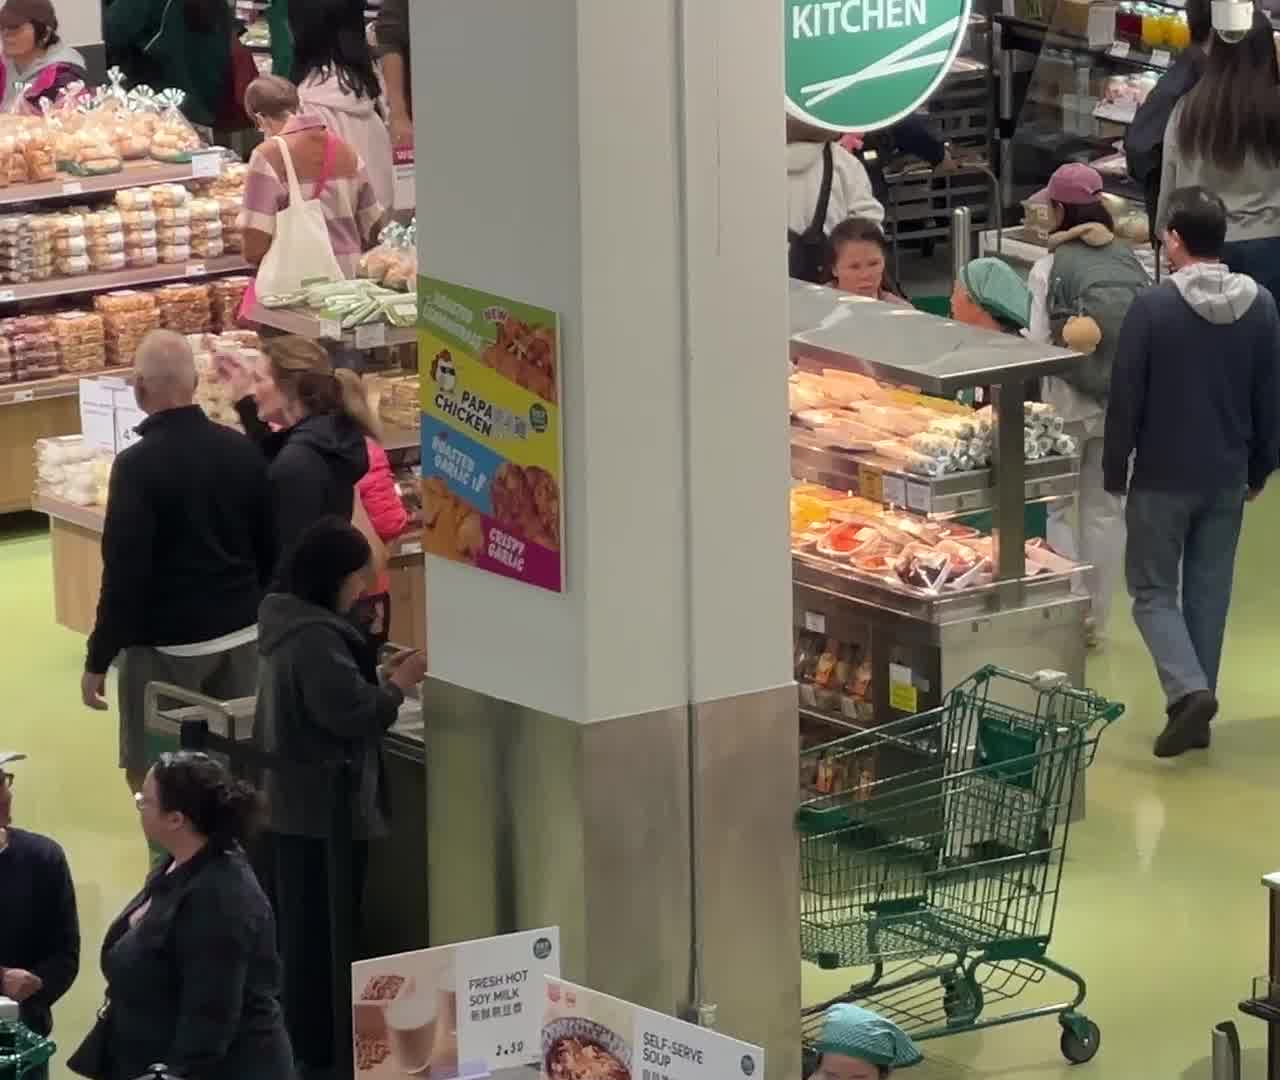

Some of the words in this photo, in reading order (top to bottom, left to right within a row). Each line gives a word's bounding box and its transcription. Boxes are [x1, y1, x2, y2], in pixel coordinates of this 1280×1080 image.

[792, 0, 927, 39] KITCHEN
[434, 393, 493, 437] CHICKEN
[462, 391, 493, 419] PAPA
[489, 527, 526, 553] CRISPY
[469, 976, 503, 991] FRESH
[505, 969, 529, 984] HOT
[469, 993, 491, 1008] SOY
[493, 987, 520, 1002] MILK
[642, 1031, 704, 1065] SELF-SERVE
[642, 1048, 672, 1068] SOUP
